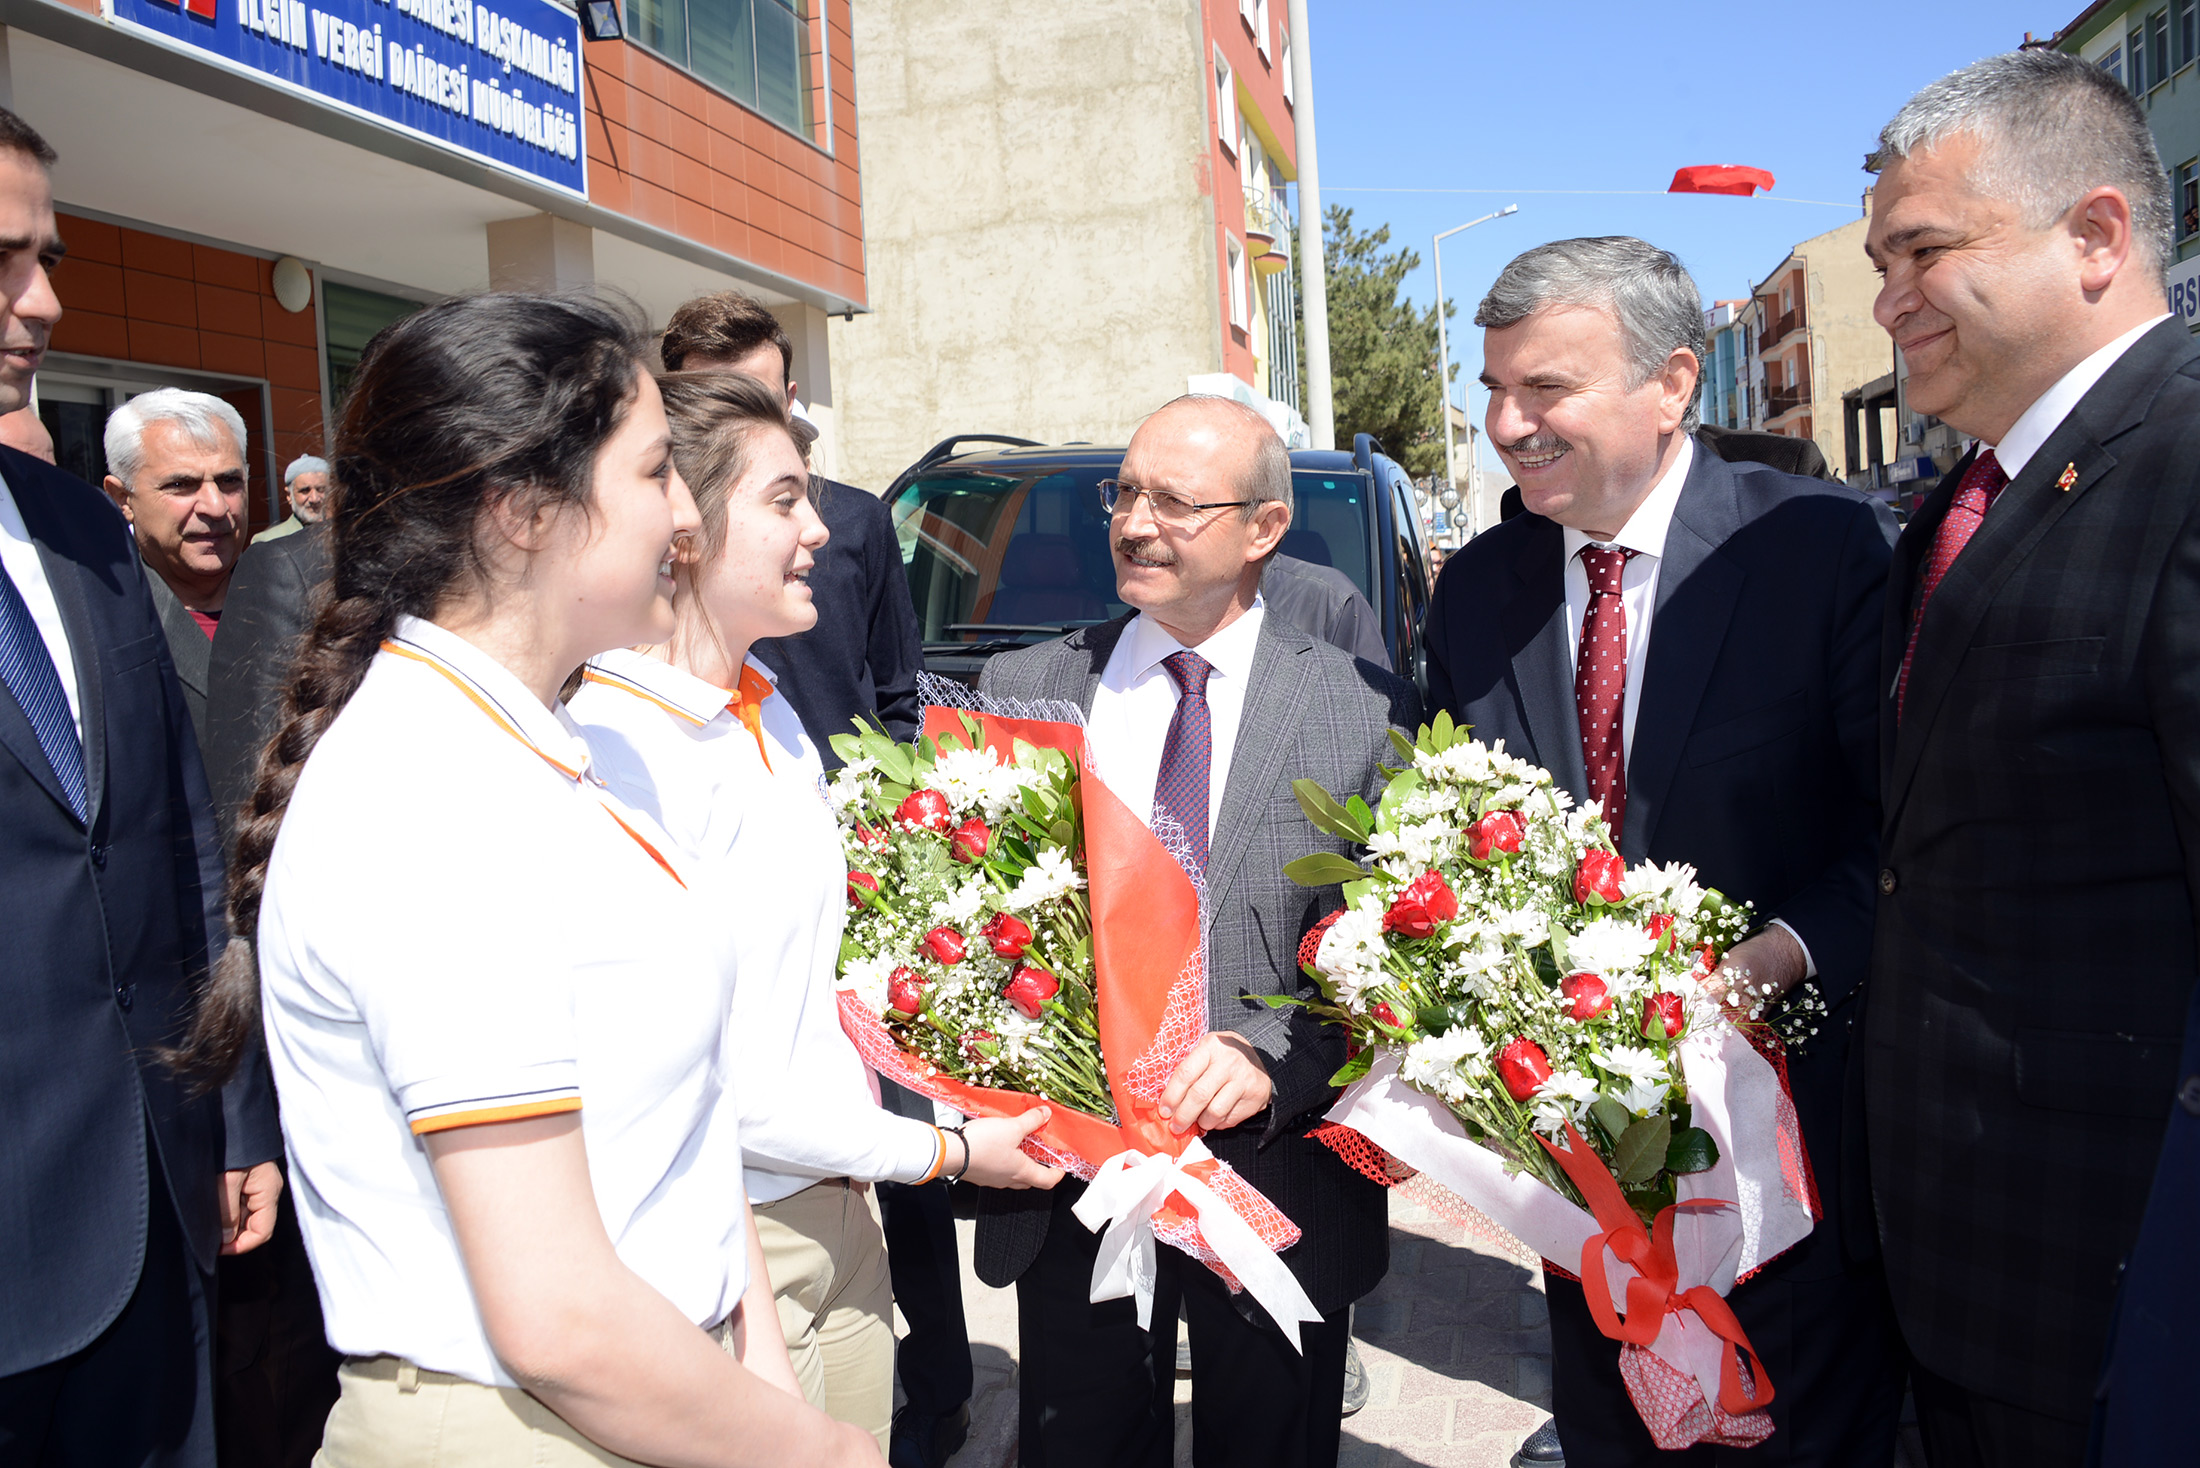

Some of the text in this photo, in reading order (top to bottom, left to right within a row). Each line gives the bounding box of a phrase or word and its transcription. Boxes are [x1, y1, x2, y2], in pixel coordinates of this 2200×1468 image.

[312, 9, 383, 80] VERGİ
[389, 41, 470, 116] DAİRESİ
[472, 77, 577, 160] MÜDÜRLÜĞÜ
[397, 0, 575, 93] RESİ BAŞKANLIĞI
